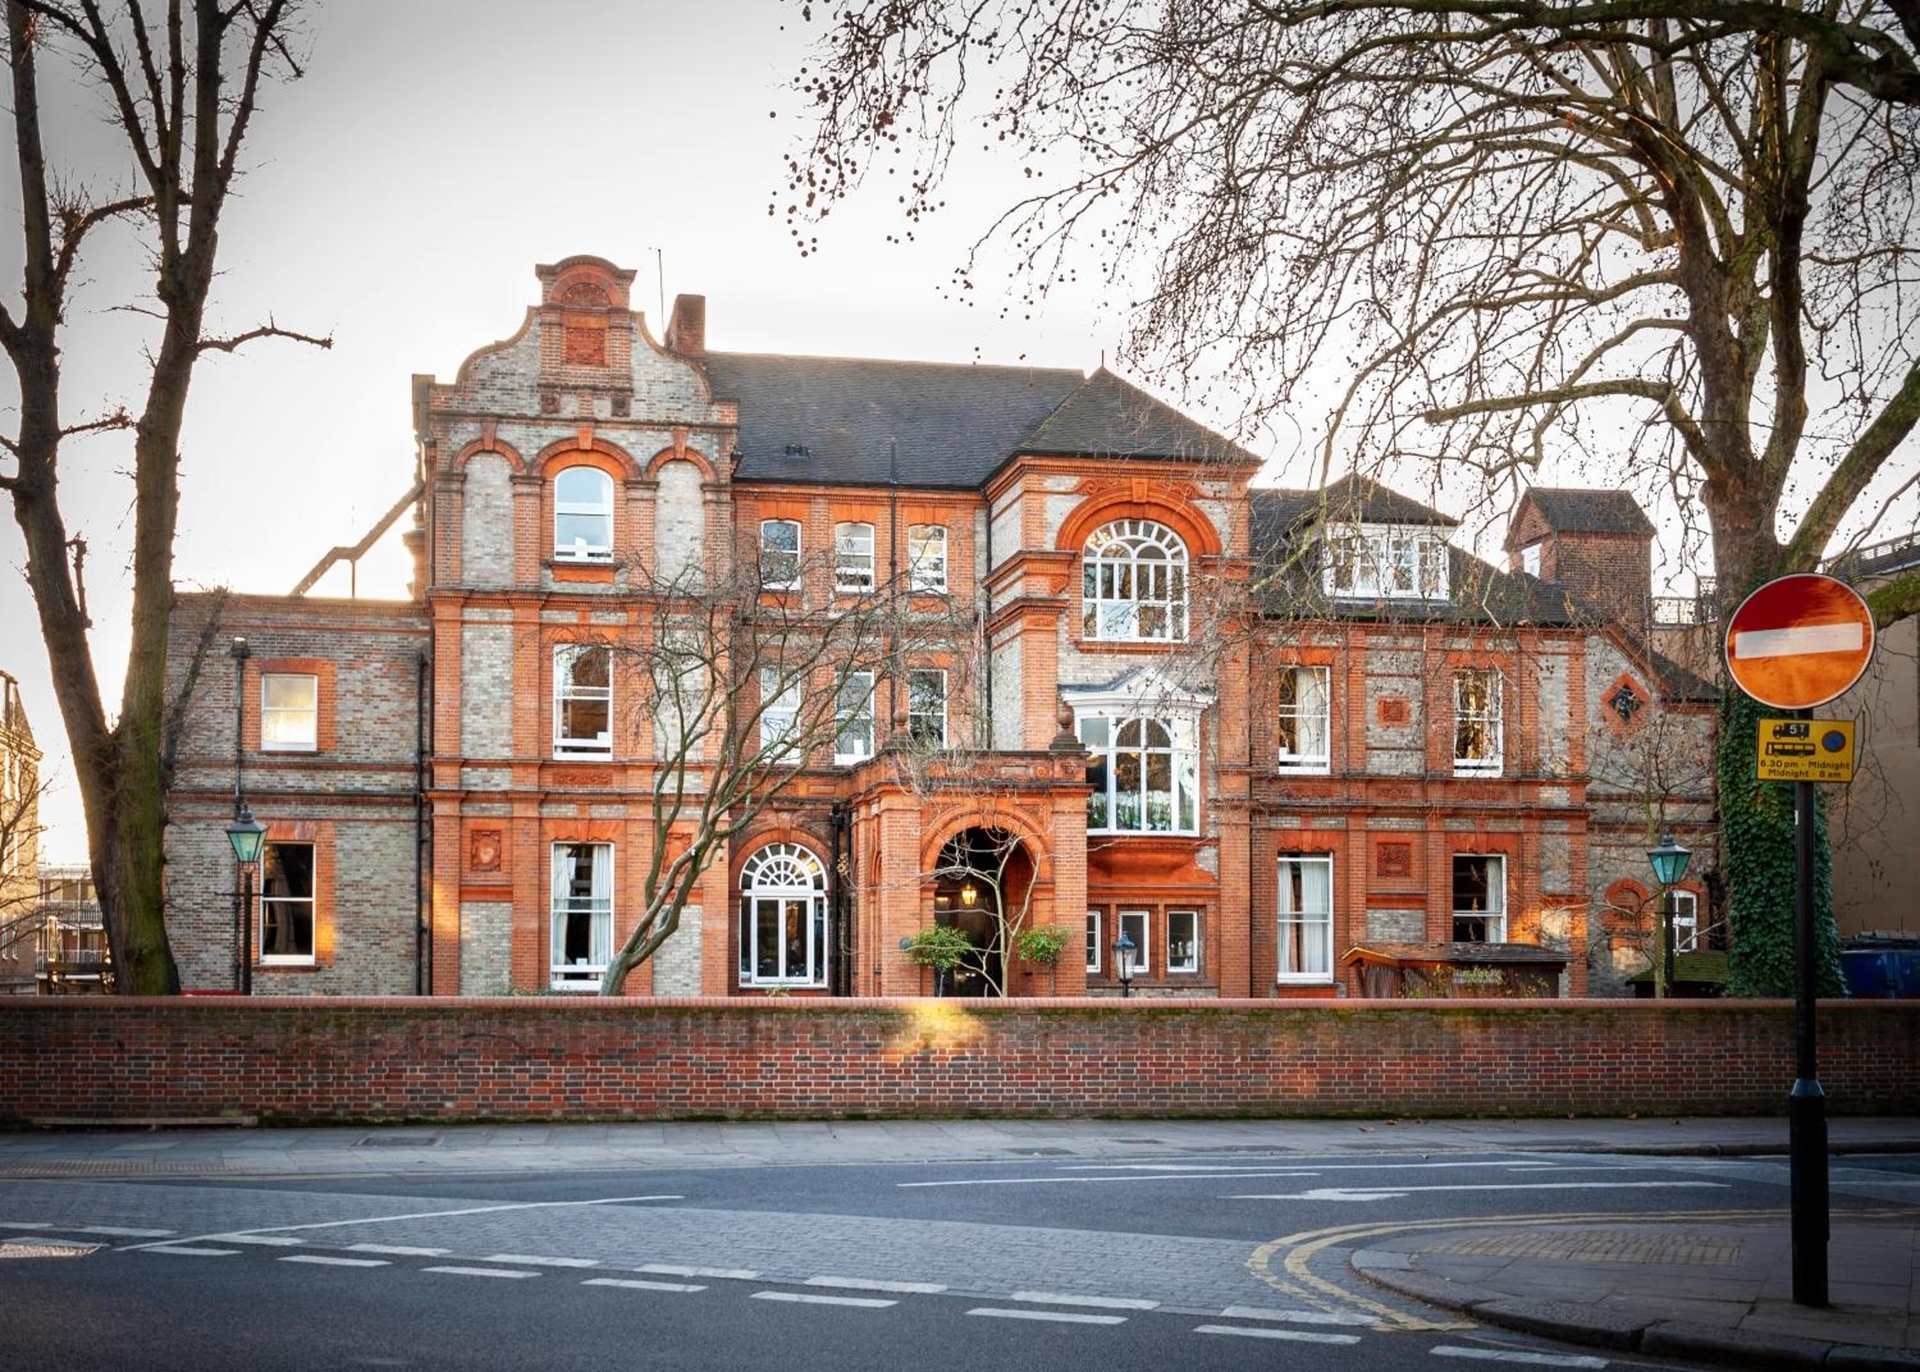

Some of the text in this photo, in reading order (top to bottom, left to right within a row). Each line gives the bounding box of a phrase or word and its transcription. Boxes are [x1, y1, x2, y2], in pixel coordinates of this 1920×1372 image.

[1760, 760, 1783, 768] 6.30
[1784, 761, 1799, 769] pm
[1808, 761, 1850, 770] Midnight
[1768, 769, 1809, 778] Midnight
